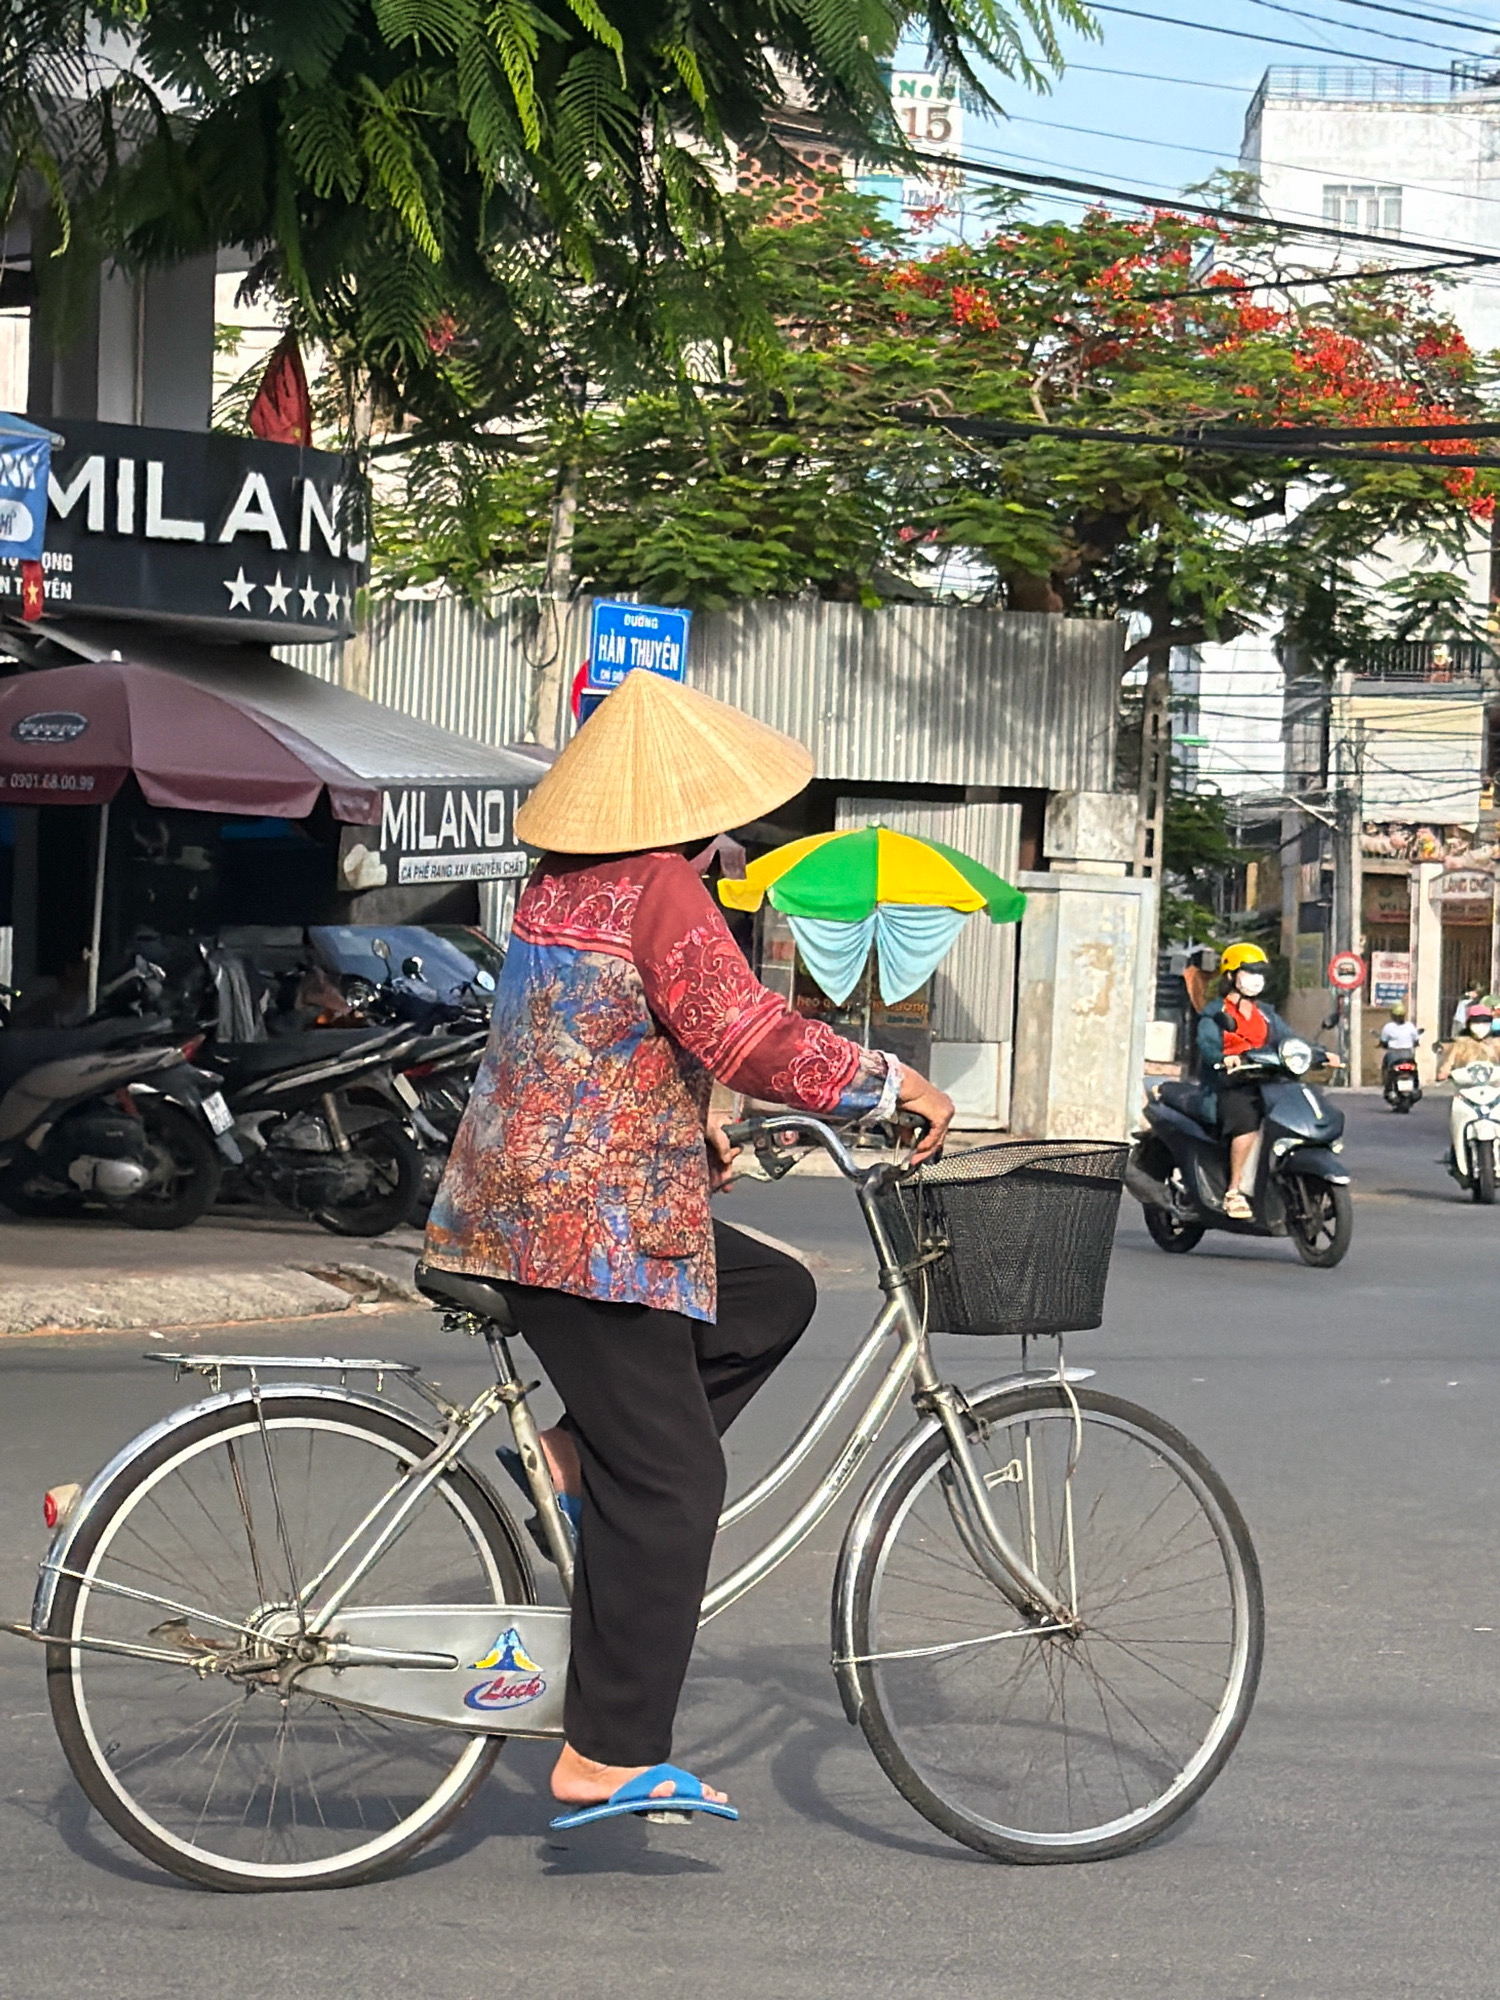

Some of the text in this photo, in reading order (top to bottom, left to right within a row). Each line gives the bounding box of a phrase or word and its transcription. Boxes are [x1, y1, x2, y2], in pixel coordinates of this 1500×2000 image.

[901, 106, 952, 144] 15
[598, 627, 680, 672] HÀN THUYÊN
[380, 789, 504, 851] MILANO
[454, 862, 469, 877] XAY
